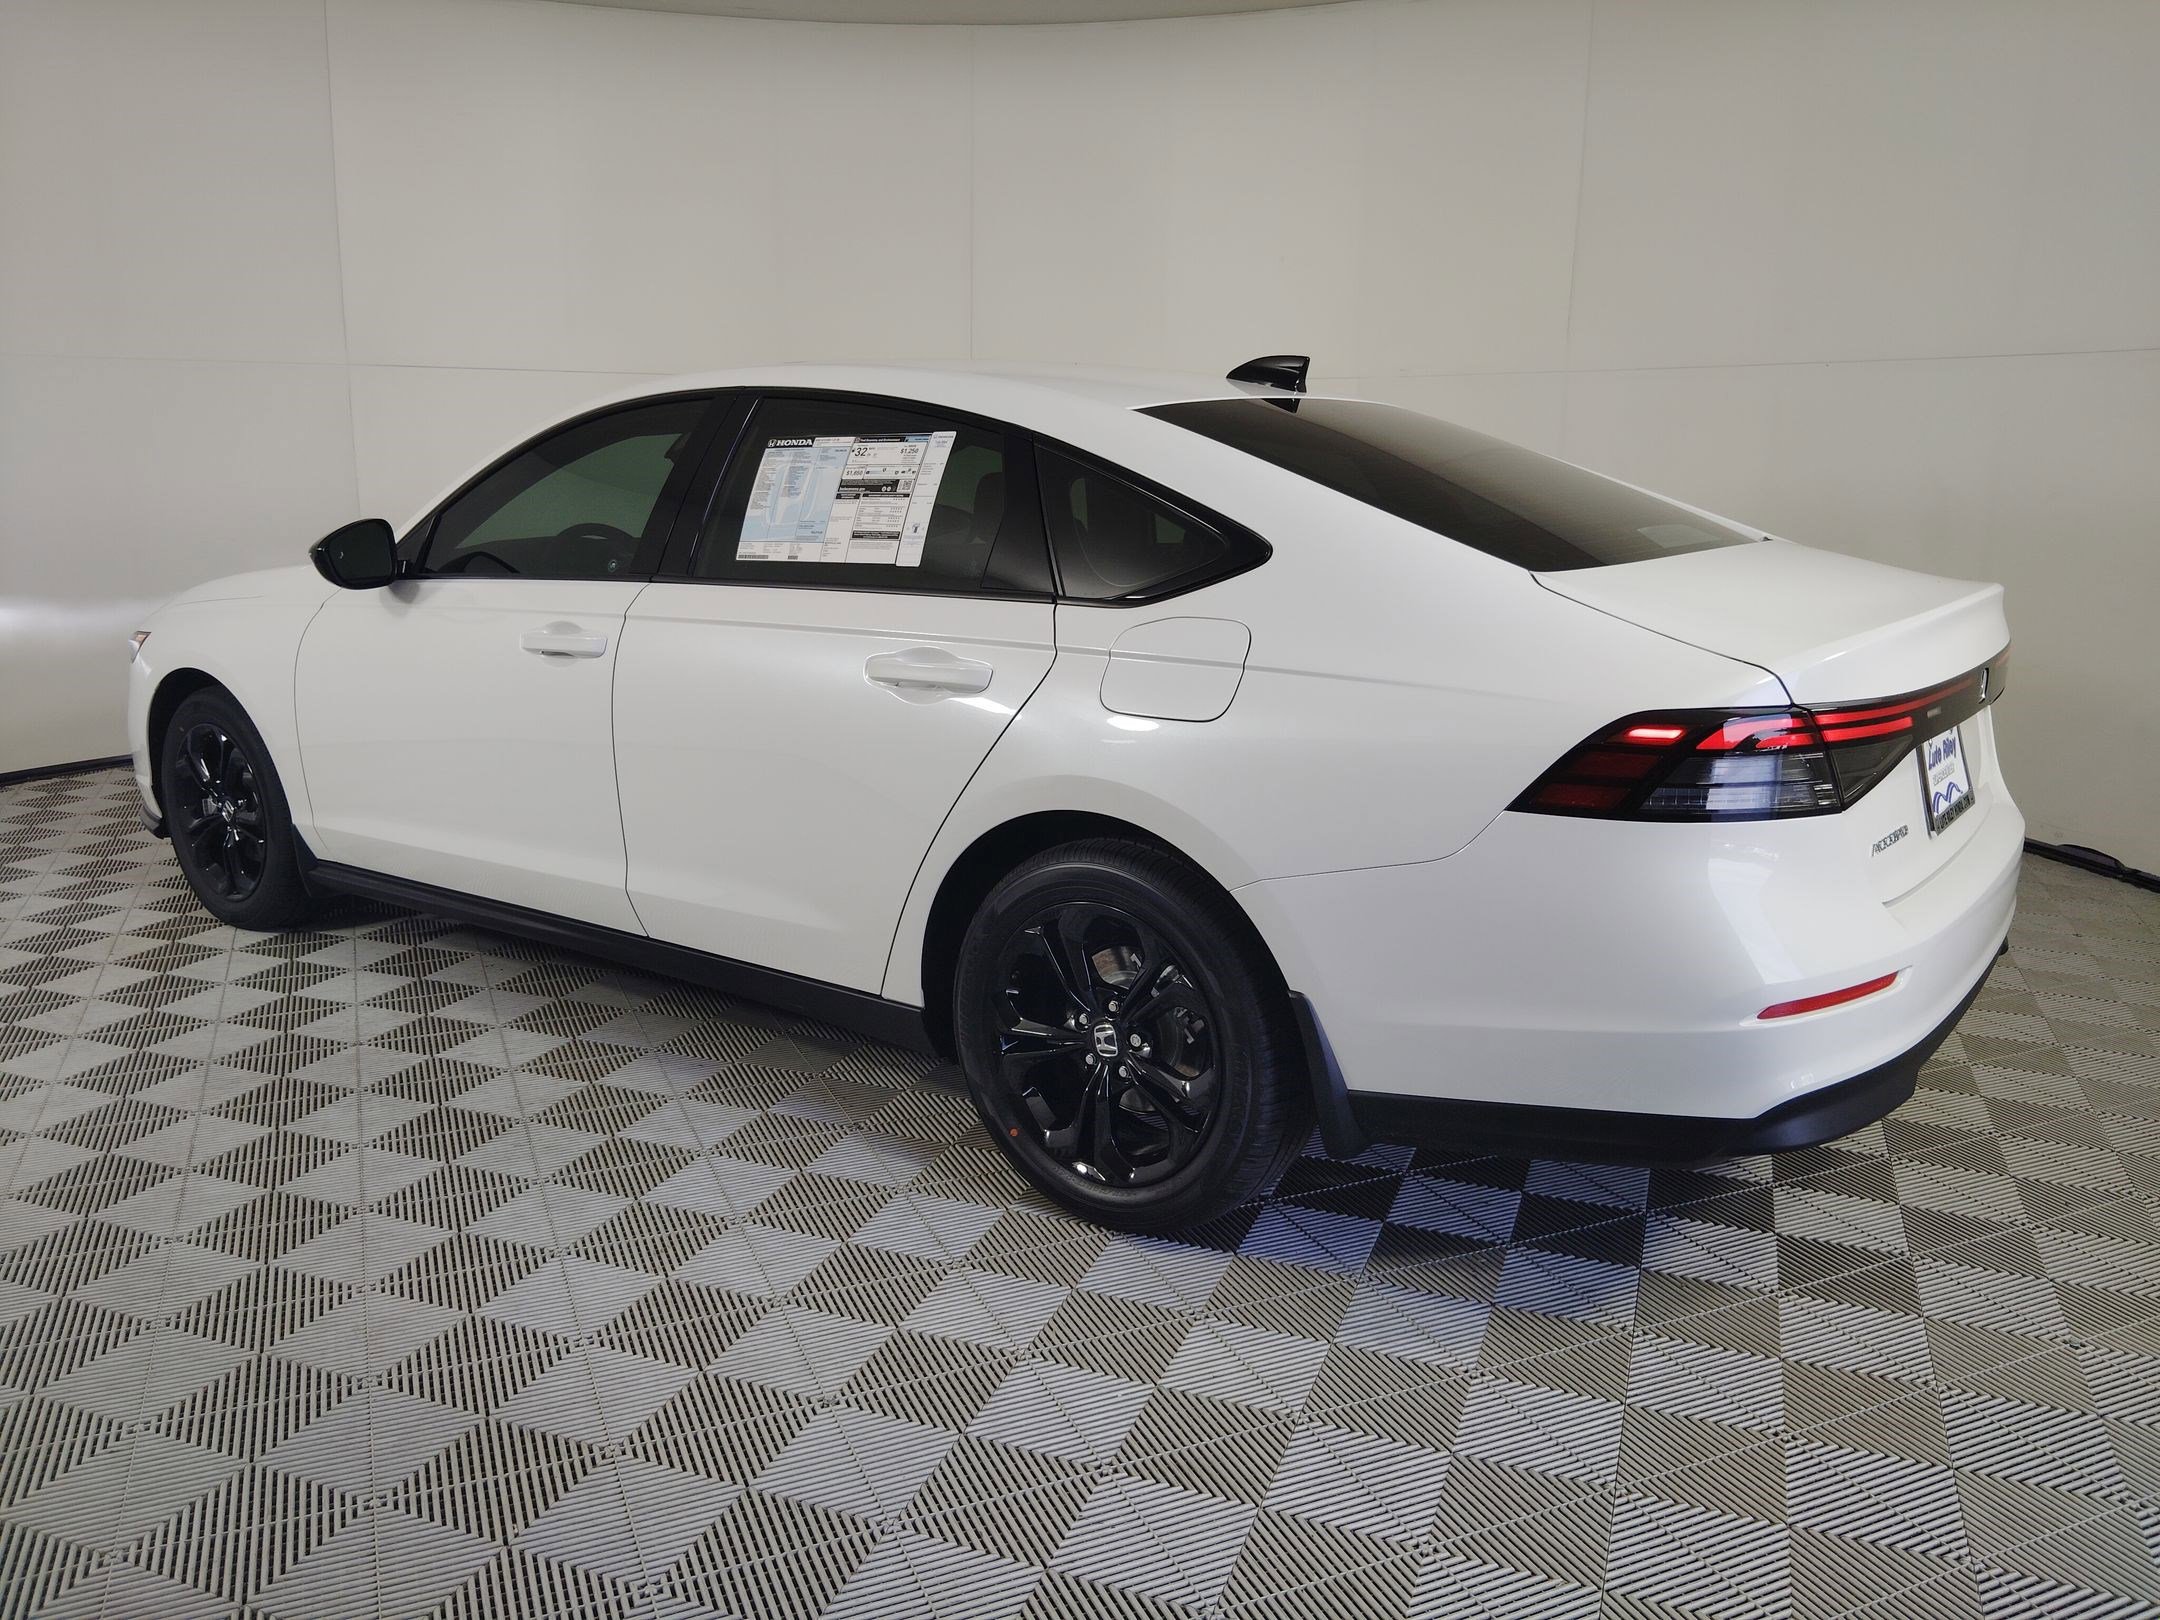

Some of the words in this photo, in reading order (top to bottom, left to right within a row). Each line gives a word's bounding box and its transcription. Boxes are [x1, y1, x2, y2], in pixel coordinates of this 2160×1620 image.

[776, 439, 813, 447] HONDA
[854, 447, 868, 457] 32
[1928, 744, 1942, 770] Lute
